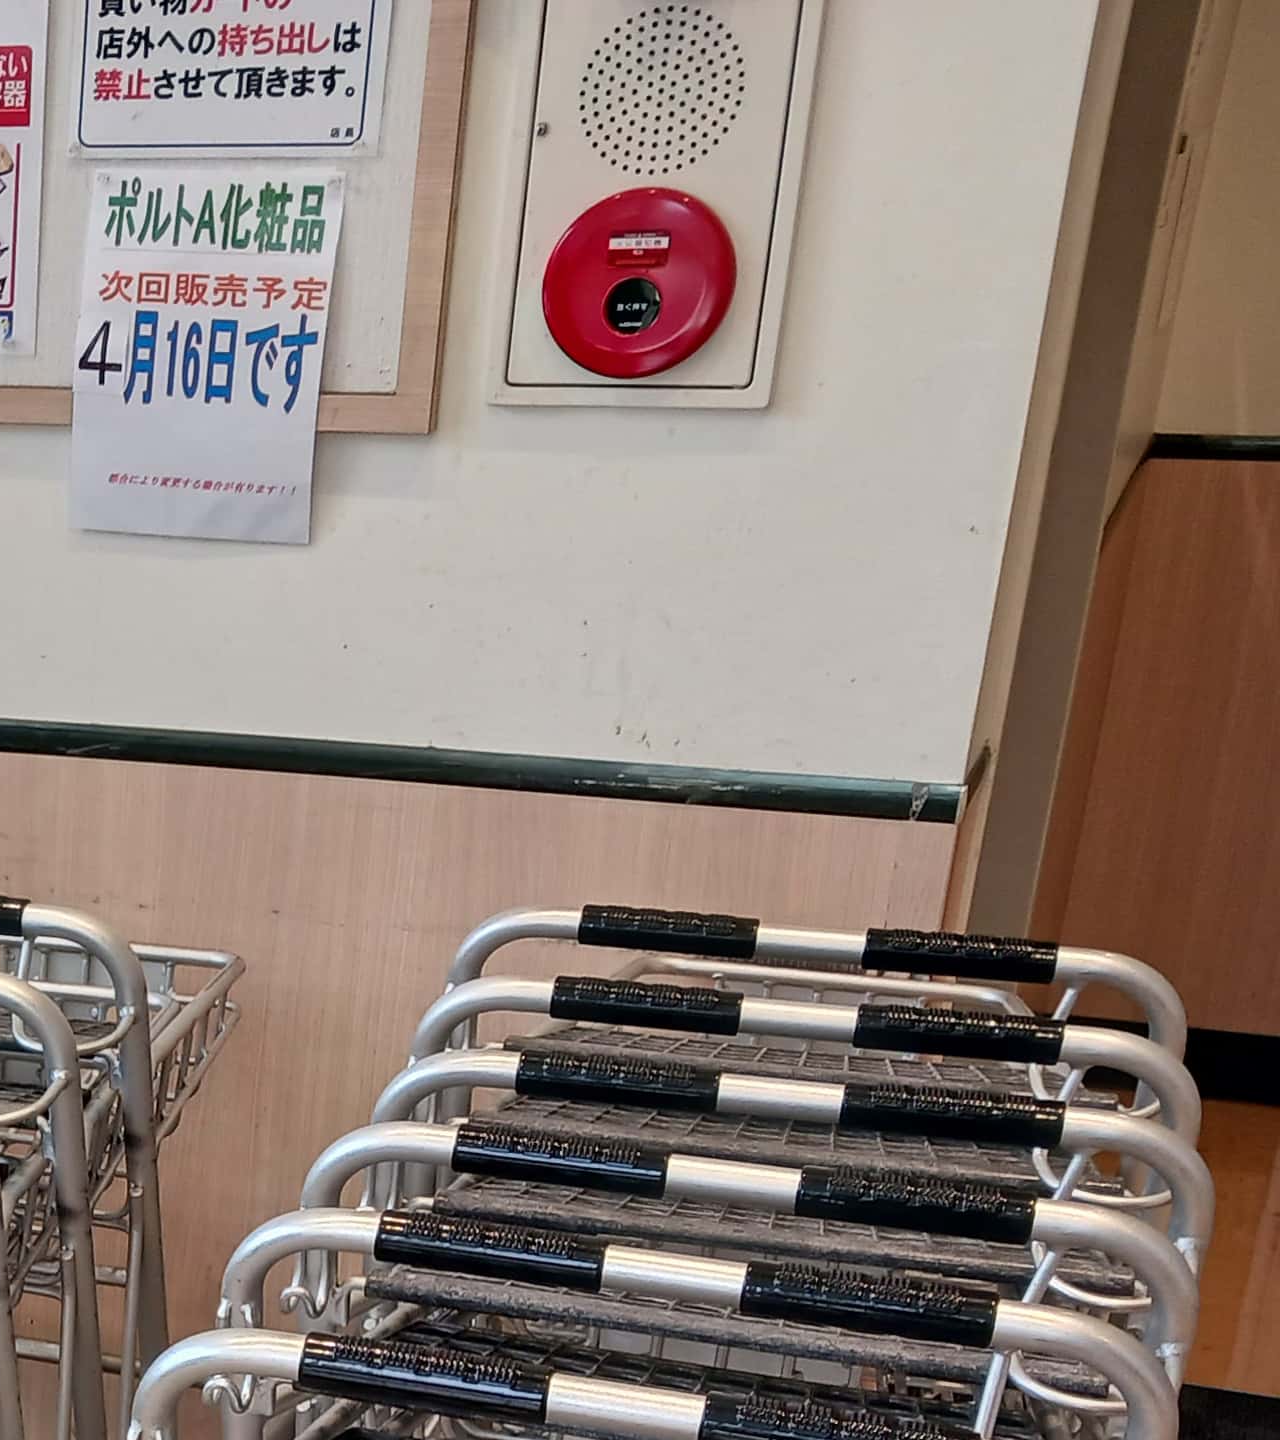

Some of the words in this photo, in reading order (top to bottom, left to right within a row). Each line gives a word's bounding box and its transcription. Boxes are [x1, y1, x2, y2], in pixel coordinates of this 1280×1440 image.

[96, 22, 361, 60] 店外への持ち出しは
[94, 65, 355, 101] 禁止させて頂きます。
[104, 176, 325, 254] ポルトA化粧品
[99, 270, 327, 312] 次回販売予定
[78, 310, 319, 414] 4月16日です
